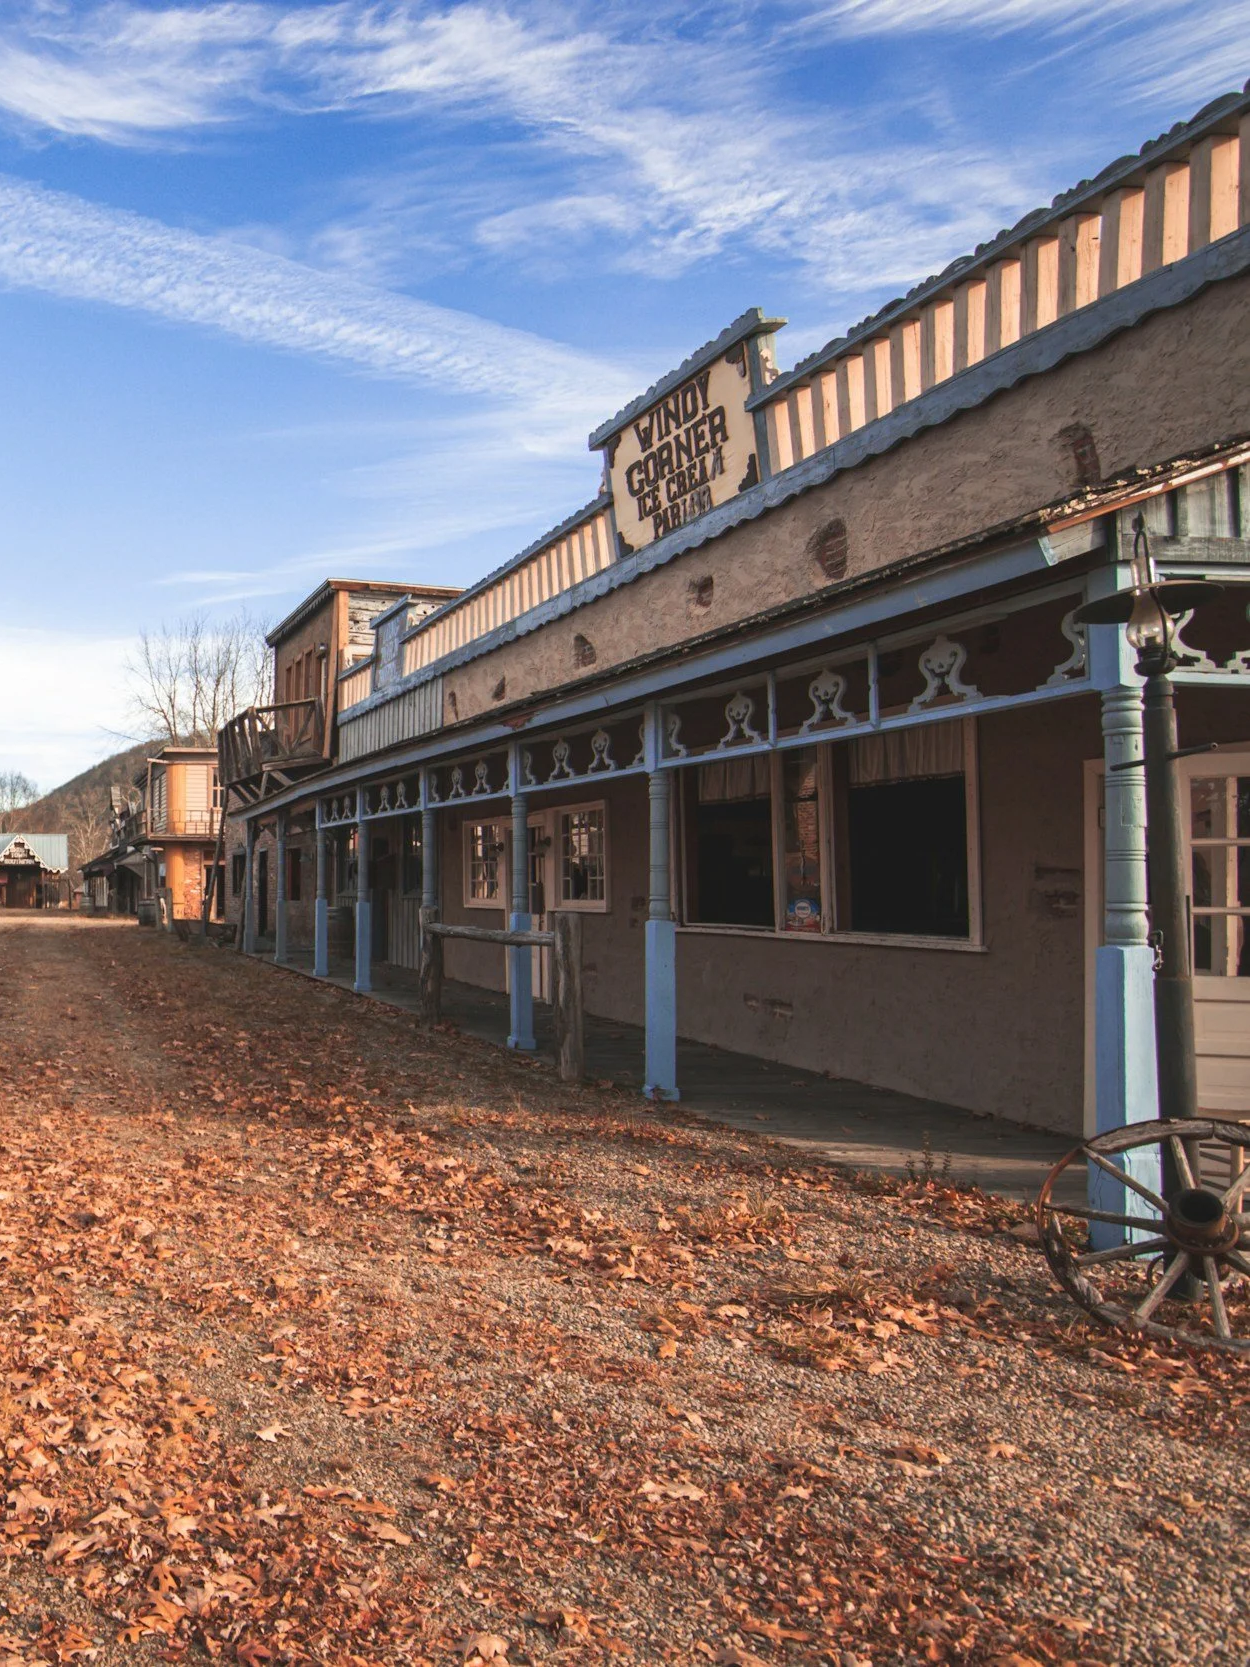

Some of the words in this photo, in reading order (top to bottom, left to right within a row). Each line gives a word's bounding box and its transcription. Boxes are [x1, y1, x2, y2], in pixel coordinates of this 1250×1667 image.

[625, 405, 729, 497] CORNER
[635, 371, 710, 453] WINDY
[637, 484, 661, 521] ICE
[666, 445, 725, 503] CREAM
